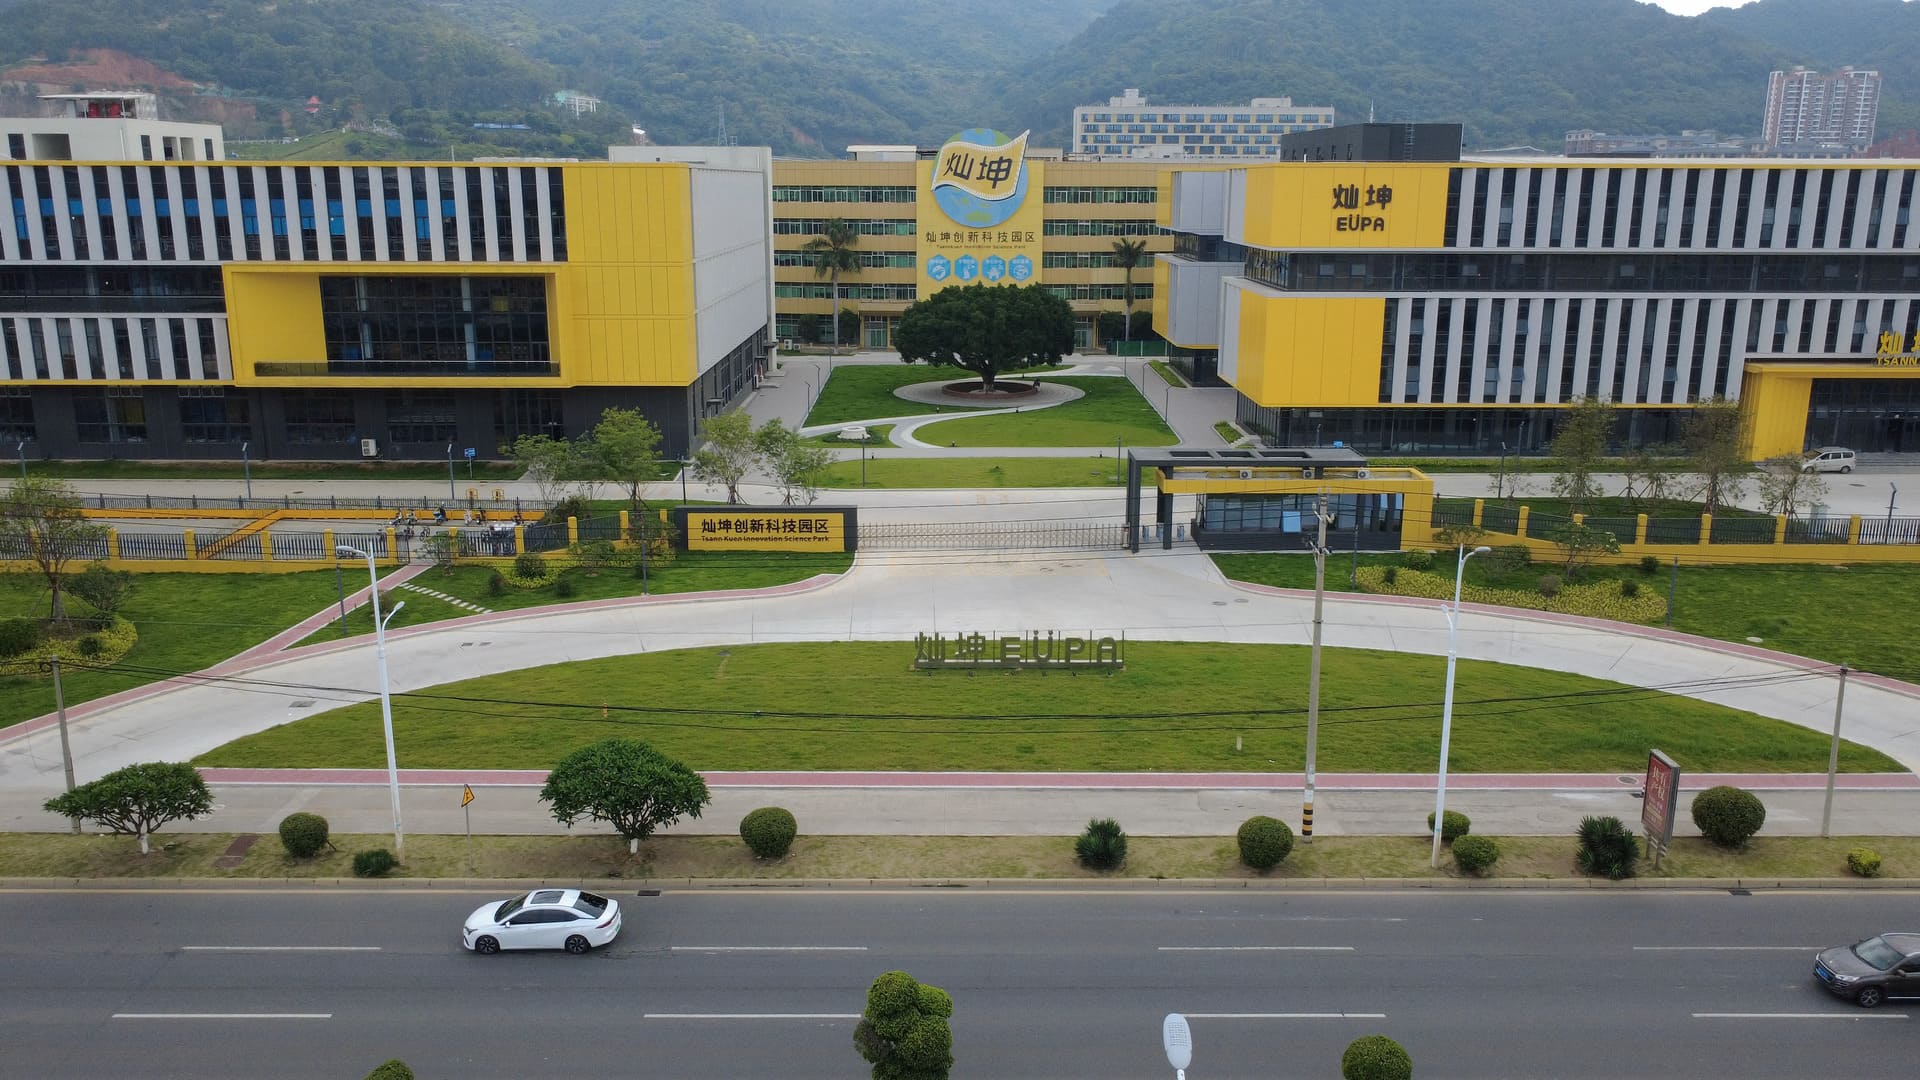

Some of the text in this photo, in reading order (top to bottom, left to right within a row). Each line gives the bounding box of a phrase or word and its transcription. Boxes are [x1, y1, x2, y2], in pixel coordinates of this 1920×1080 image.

[943, 152, 1013, 189] 灿坤
[1332, 184, 1393, 210] 灿坤
[926, 231, 1036, 243] 灿坤创新科技园区
[701, 518, 829, 533] 灿坤创新科技园区
[914, 631, 985, 663] 灿坤
